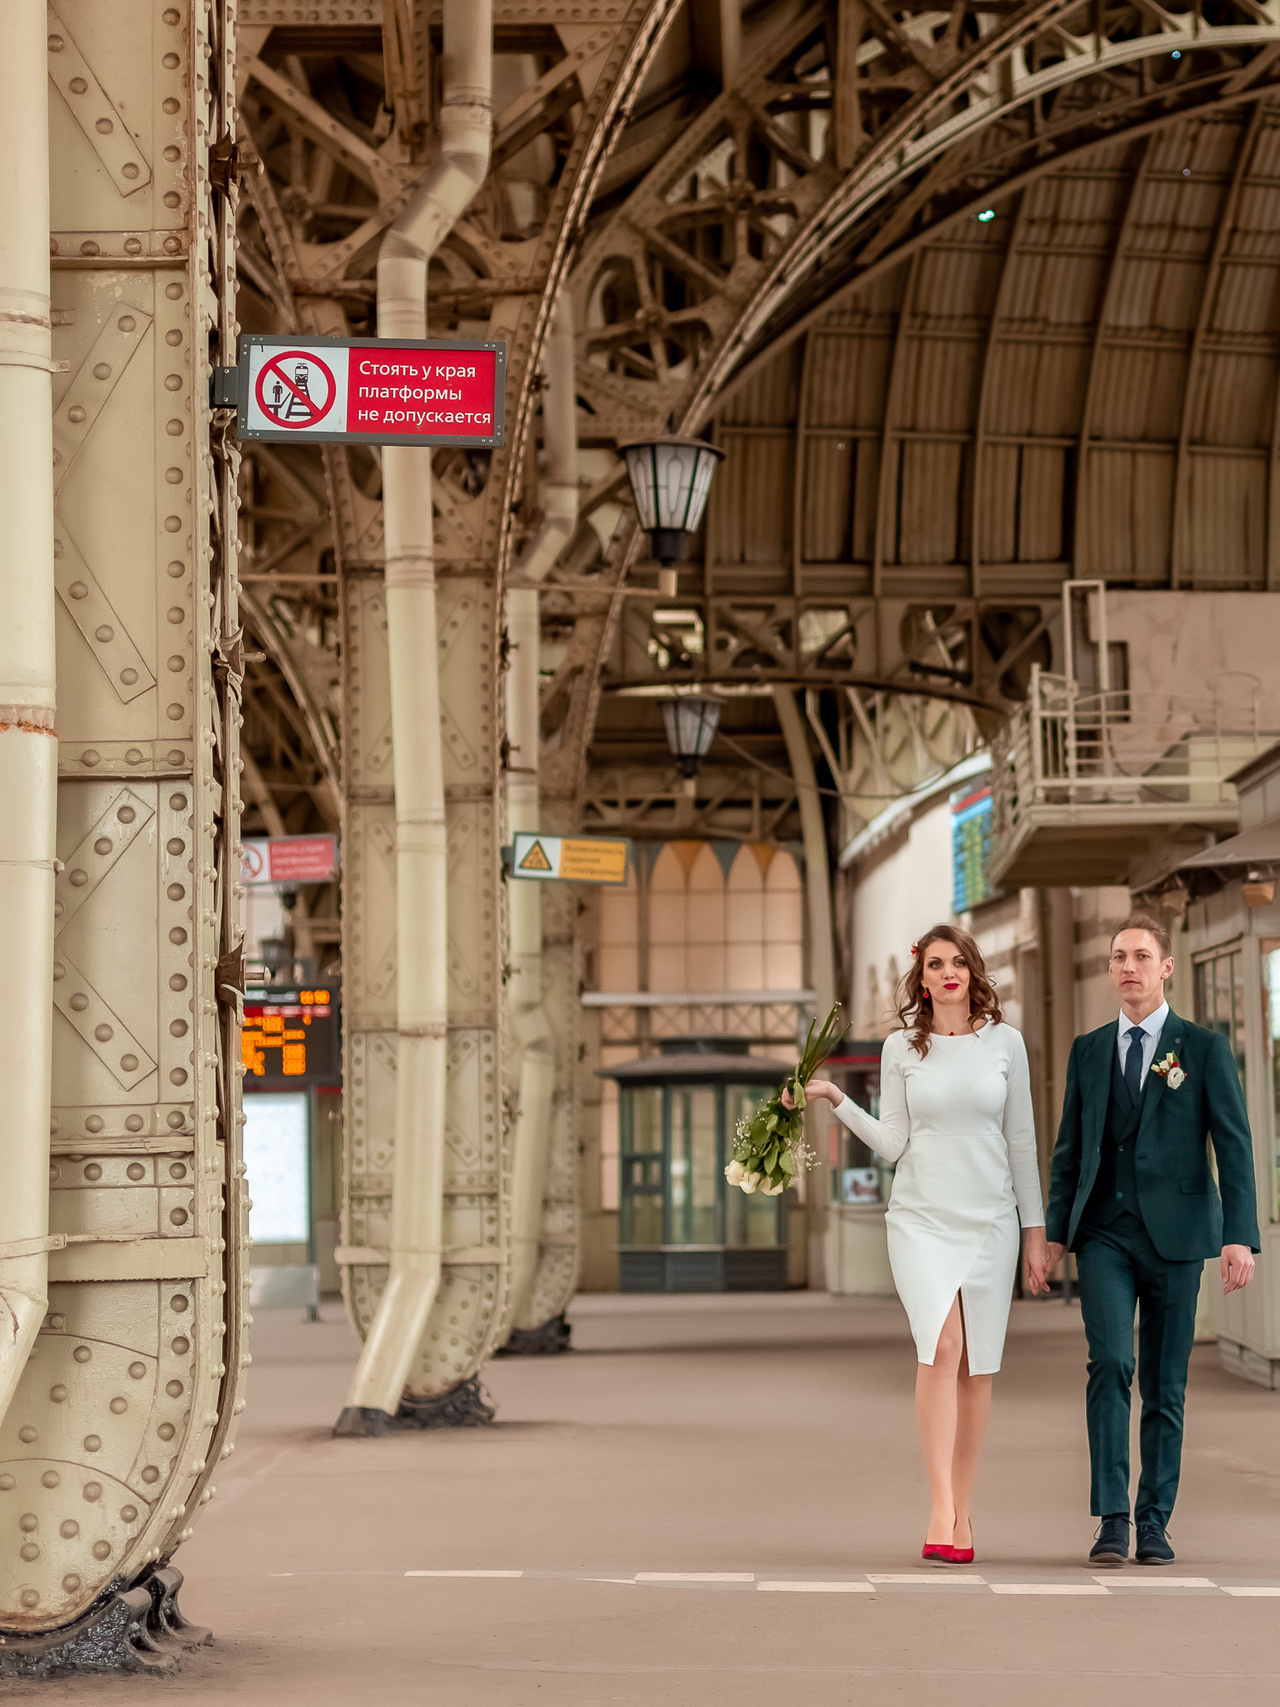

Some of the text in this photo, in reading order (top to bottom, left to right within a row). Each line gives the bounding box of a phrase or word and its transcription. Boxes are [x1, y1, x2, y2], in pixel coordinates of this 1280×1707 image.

[359, 360, 476, 381] Стоять у края
[358, 384, 462, 403] платформы
[358, 409, 492, 426] не допускается
